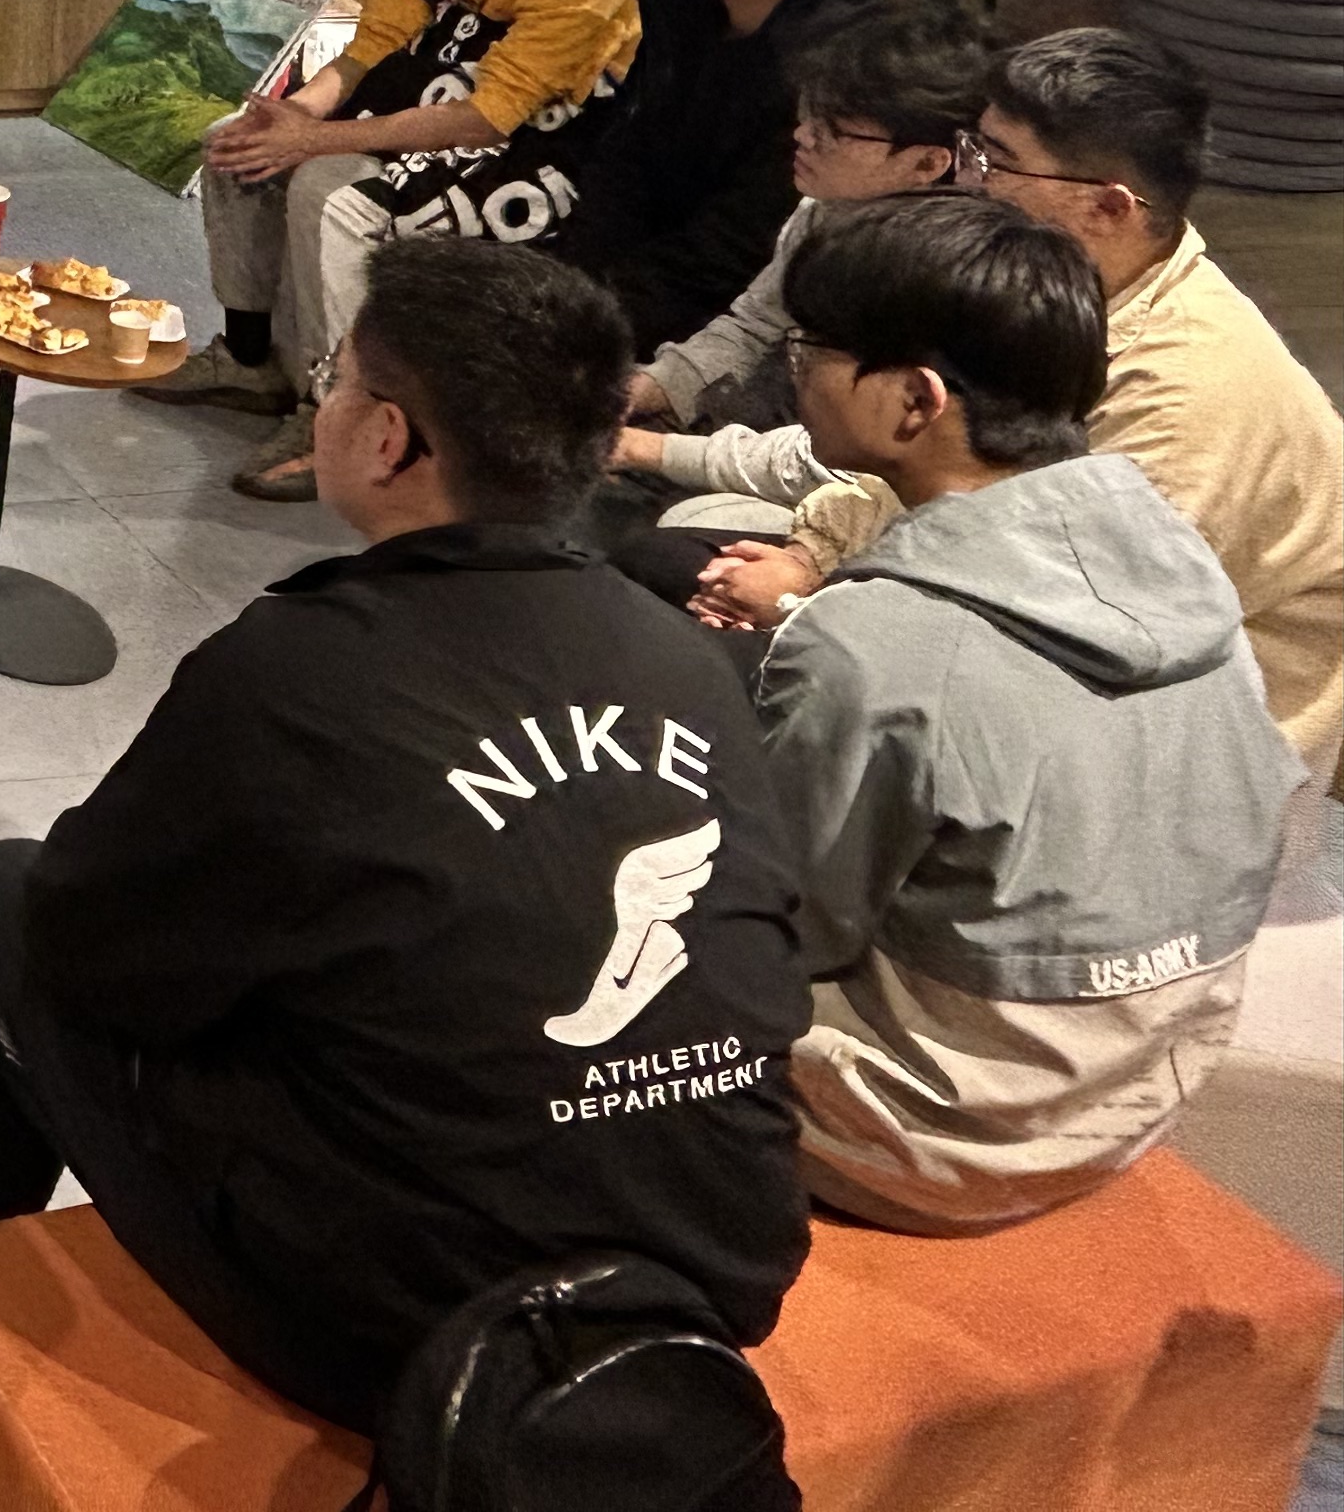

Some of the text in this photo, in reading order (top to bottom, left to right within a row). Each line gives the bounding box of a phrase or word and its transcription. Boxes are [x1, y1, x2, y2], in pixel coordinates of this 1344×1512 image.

[446, 704, 712, 831] NIKE
[549, 1055, 769, 1124] DEPARTMENT
[583, 1035, 742, 1090] ATHLETIC
